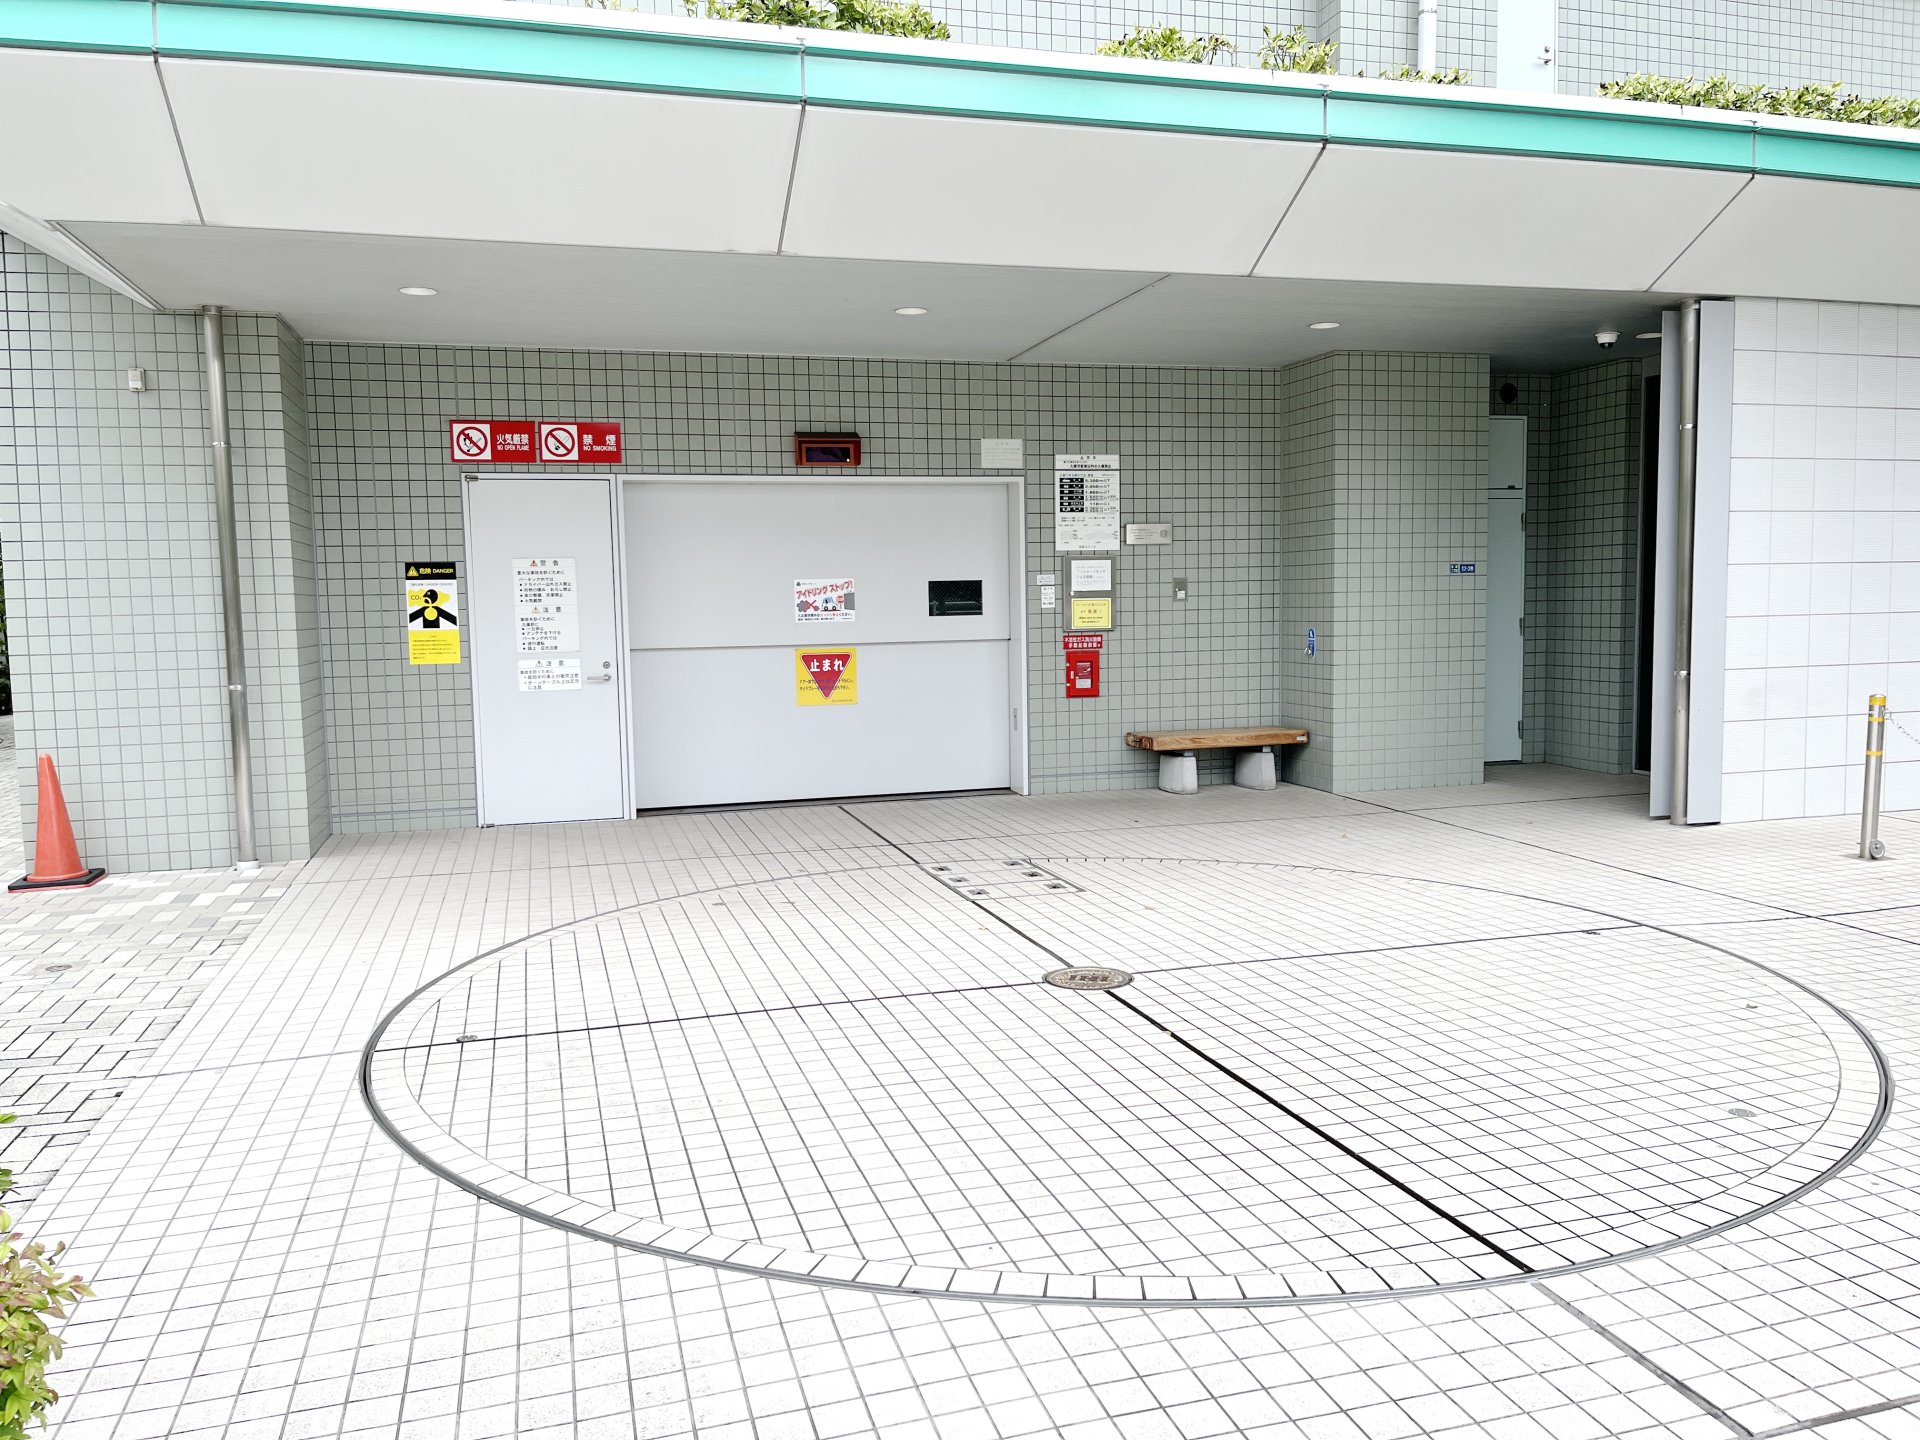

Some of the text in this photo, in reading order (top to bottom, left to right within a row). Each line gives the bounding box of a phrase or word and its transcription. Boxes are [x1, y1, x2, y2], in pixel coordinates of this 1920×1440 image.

[496, 434, 529, 444] 火気厳禁
[582, 434, 616, 445] 禁煙
[796, 585, 828, 599] アイドリング
[810, 658, 844, 672] 止まれ
